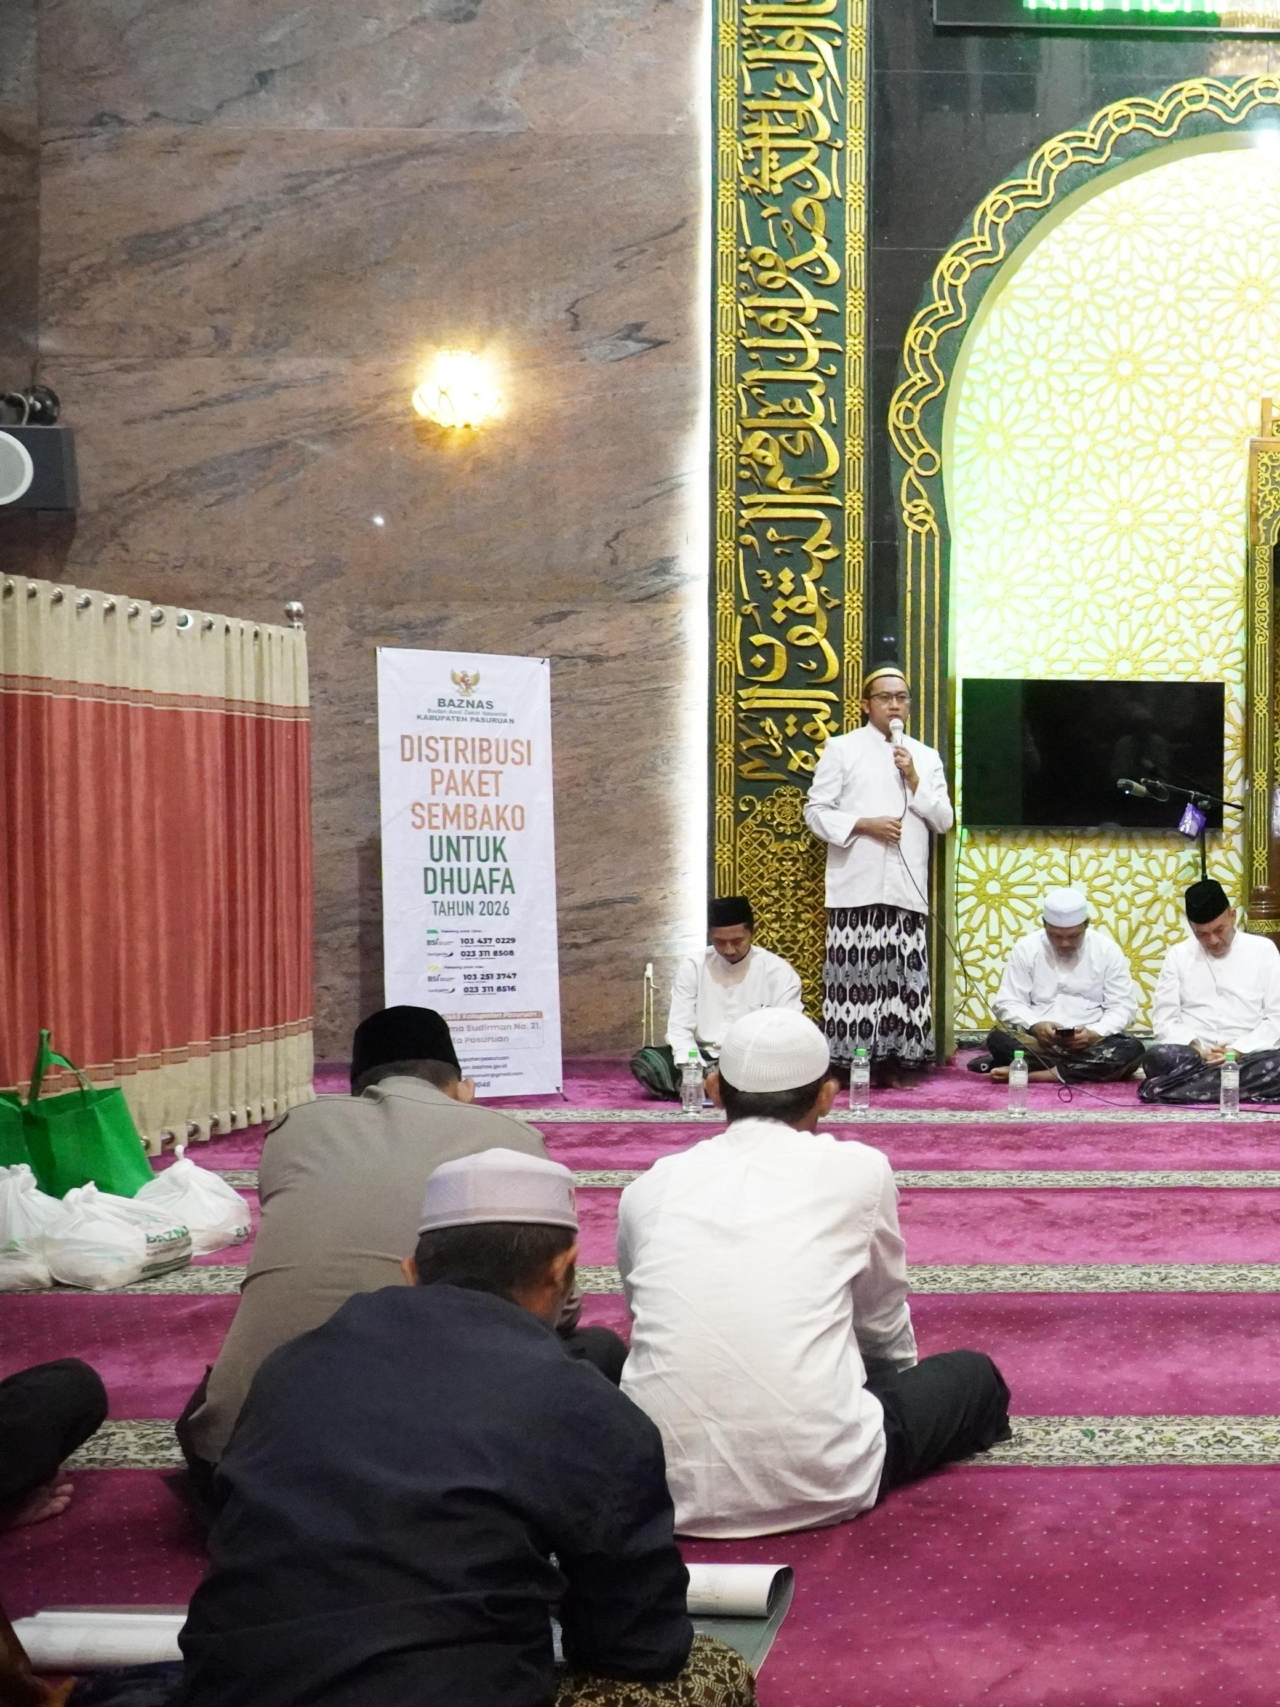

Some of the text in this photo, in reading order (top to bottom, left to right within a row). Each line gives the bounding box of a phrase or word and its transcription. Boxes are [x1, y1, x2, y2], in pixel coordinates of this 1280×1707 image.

[437, 698, 494, 710] BAZNAS
[416, 714, 515, 724] KABUPATEN PASURUAN
[400, 734, 532, 766] DISTRIBUSI
[430, 768, 503, 797] PAKET
[411, 802, 525, 832] SEMBAKO
[429, 835, 508, 863] UNTUK
[423, 867, 516, 895] DHUAFA
[431, 901, 510, 916] TAHUN 2026
[463, 973, 477, 981] 103
[496, 985, 516, 993] 8516
[466, 1024, 512, 1032] Sudirman
[514, 1022, 529, 1030] No.
[465, 1035, 509, 1044] Pasuruan
